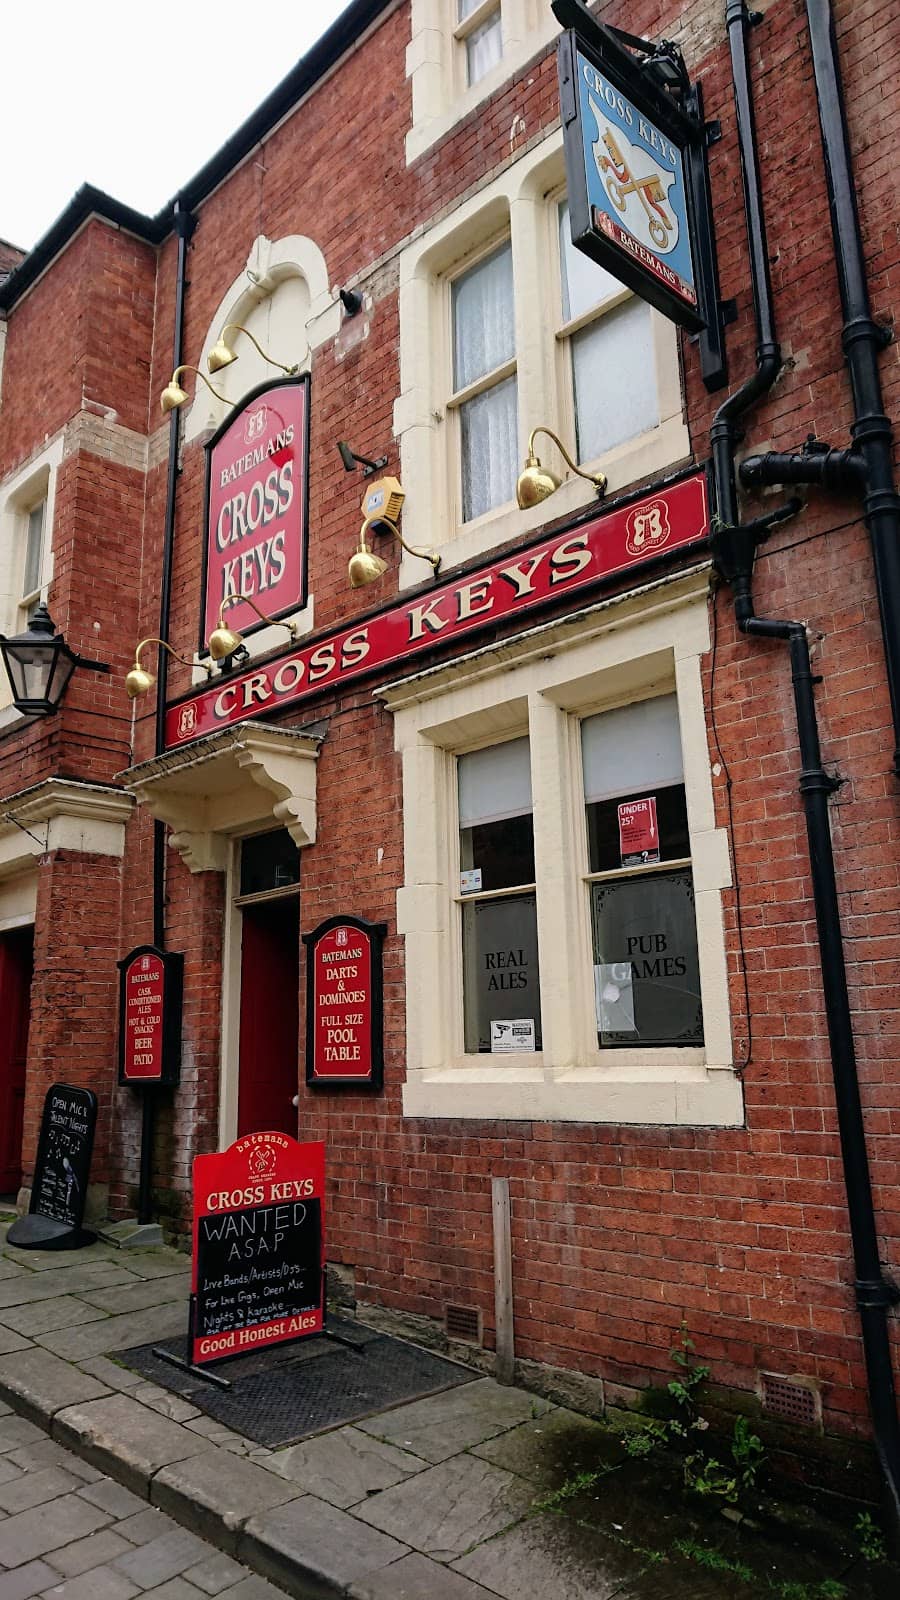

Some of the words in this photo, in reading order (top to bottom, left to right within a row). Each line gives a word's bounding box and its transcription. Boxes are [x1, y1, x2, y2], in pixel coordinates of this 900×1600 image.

[583, 64, 633, 126] CROSS
[638, 118, 678, 166] KEYS
[619, 229, 677, 285] BATEMANS
[219, 424, 295, 489] BATEMANS
[217, 459, 294, 551] CROSS
[222, 529, 287, 610] KEYS
[213, 628, 371, 719] CROSS
[407, 533, 593, 644] KEYS
[620, 802, 648, 815] UNDER
[621, 816, 634, 826] 25?
[626, 933, 668, 956] PUB
[322, 947, 363, 963] BATEMANS
[484, 949, 529, 970] REAL
[326, 965, 358, 981] DARTS
[611, 956, 687, 980] GAMES
[337, 980, 346, 991] &
[487, 971, 528, 992] ALES
[319, 990, 366, 1006] DOMINOES
[137, 1005, 152, 1014] ALES
[146, 1016, 160, 1025] COLD
[321, 1015, 343, 1027] FULL
[344, 1013, 364, 1025] SIZE
[134, 1038, 153, 1049] BEER
[327, 1028, 358, 1044] POOL
[133, 1054, 154, 1065] PATIO
[324, 1045, 361, 1061] TABLE
[51, 1096, 67, 1111] OPEN
[69, 1101, 82, 1116] MIC
[236, 1135, 289, 1153] batemans
[206, 1185, 265, 1211] CROSS
[271, 1178, 315, 1201] KEYS
[203, 1202, 307, 1241] WANTED
[227, 1232, 284, 1262] ASAP
[203, 1311, 235, 1329] Nights
[200, 1332, 235, 1355] Good
[239, 1321, 286, 1345] Honest
[288, 1315, 317, 1333] Ales
